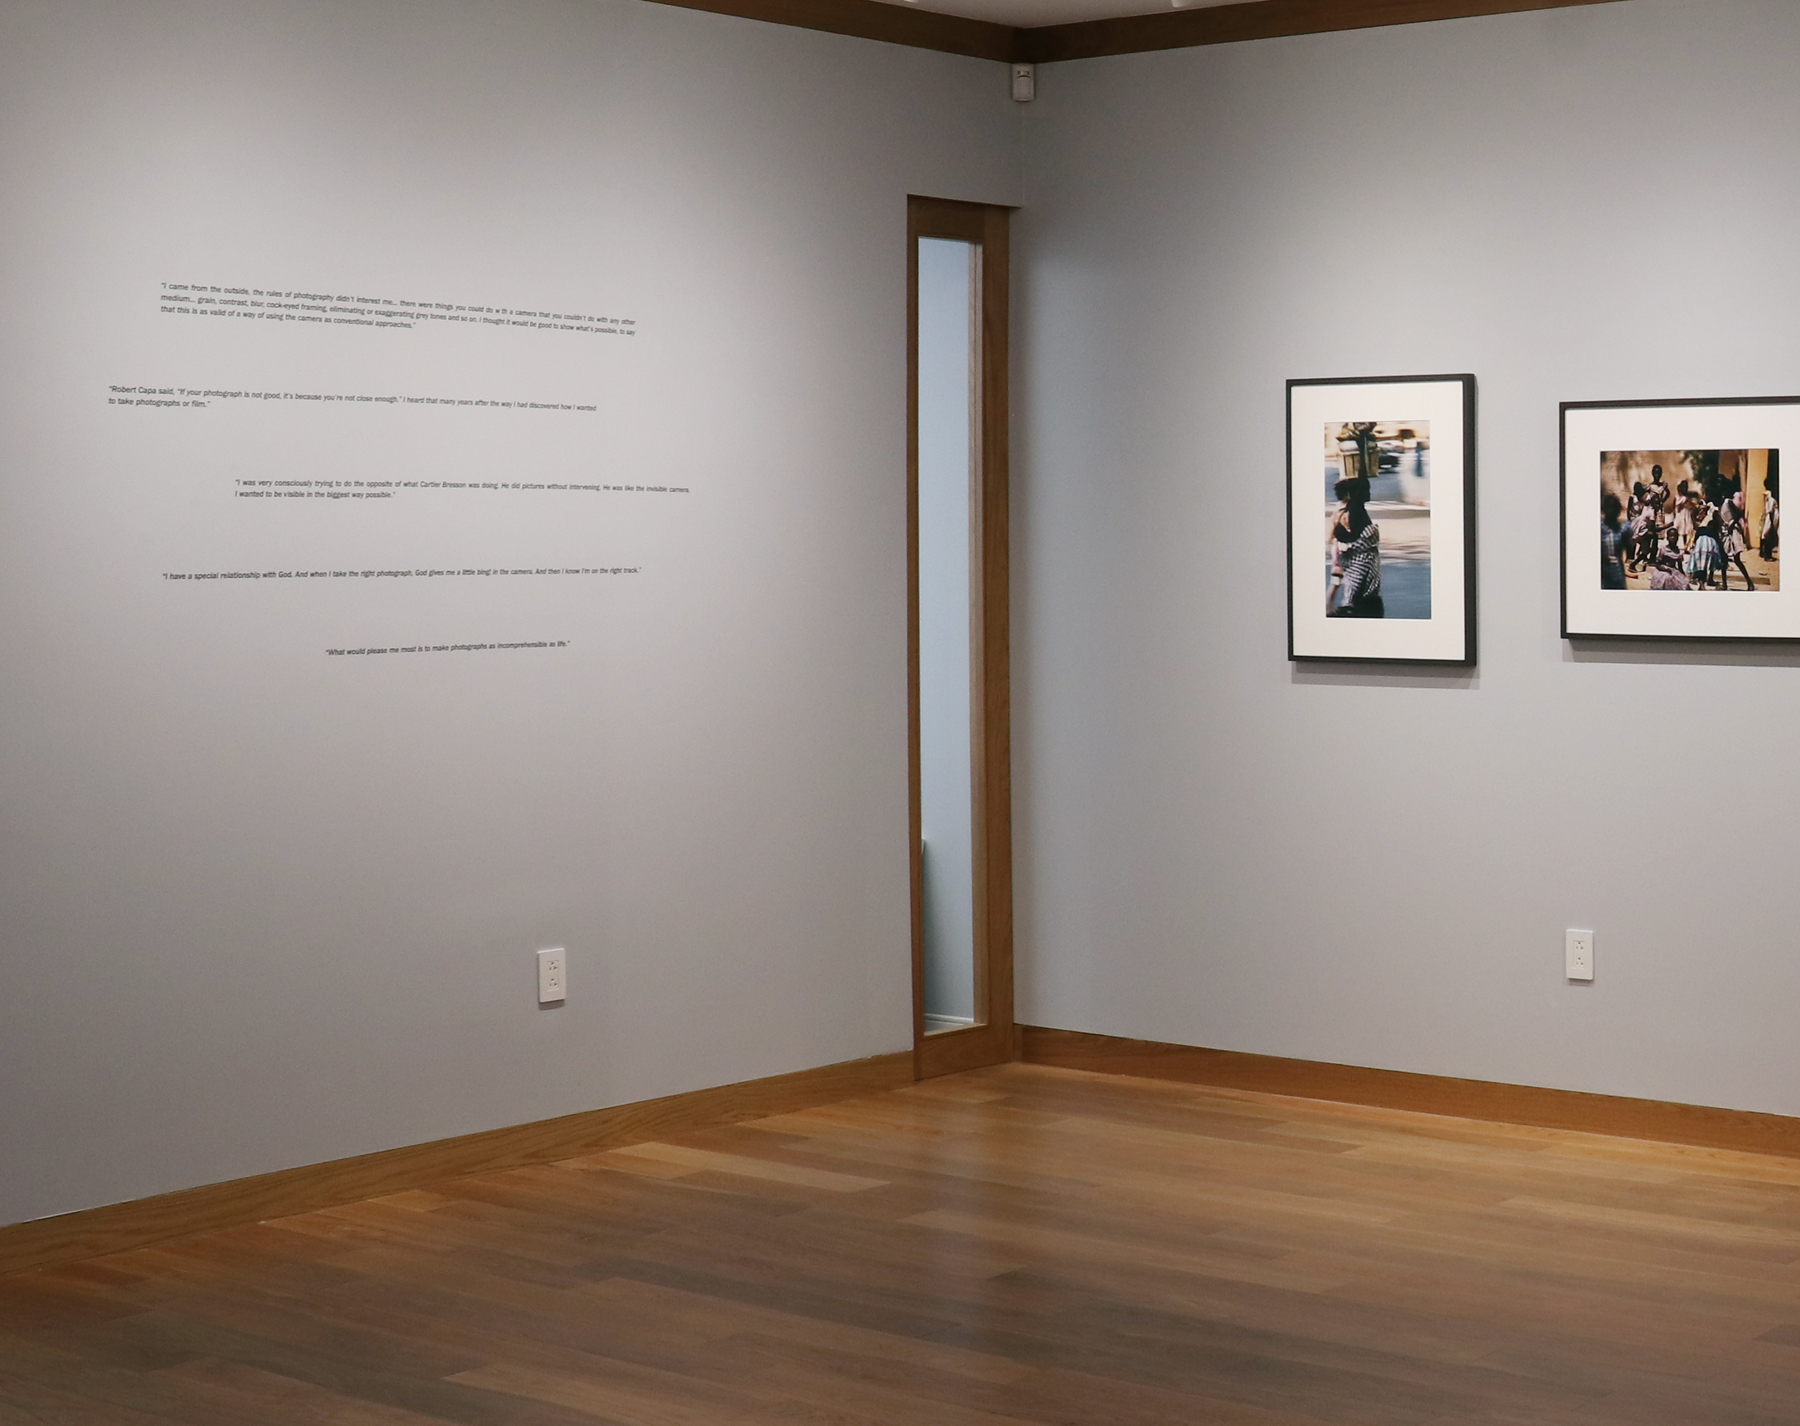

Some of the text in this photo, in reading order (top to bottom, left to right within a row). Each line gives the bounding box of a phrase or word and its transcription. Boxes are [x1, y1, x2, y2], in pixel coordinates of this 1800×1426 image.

[293, 293, 333, 301] photography
[329, 306, 365, 315] eliminating
[375, 310, 414, 318] exaggerating
[138, 386, 156, 394] Capa
[135, 399, 180, 407] photographs
